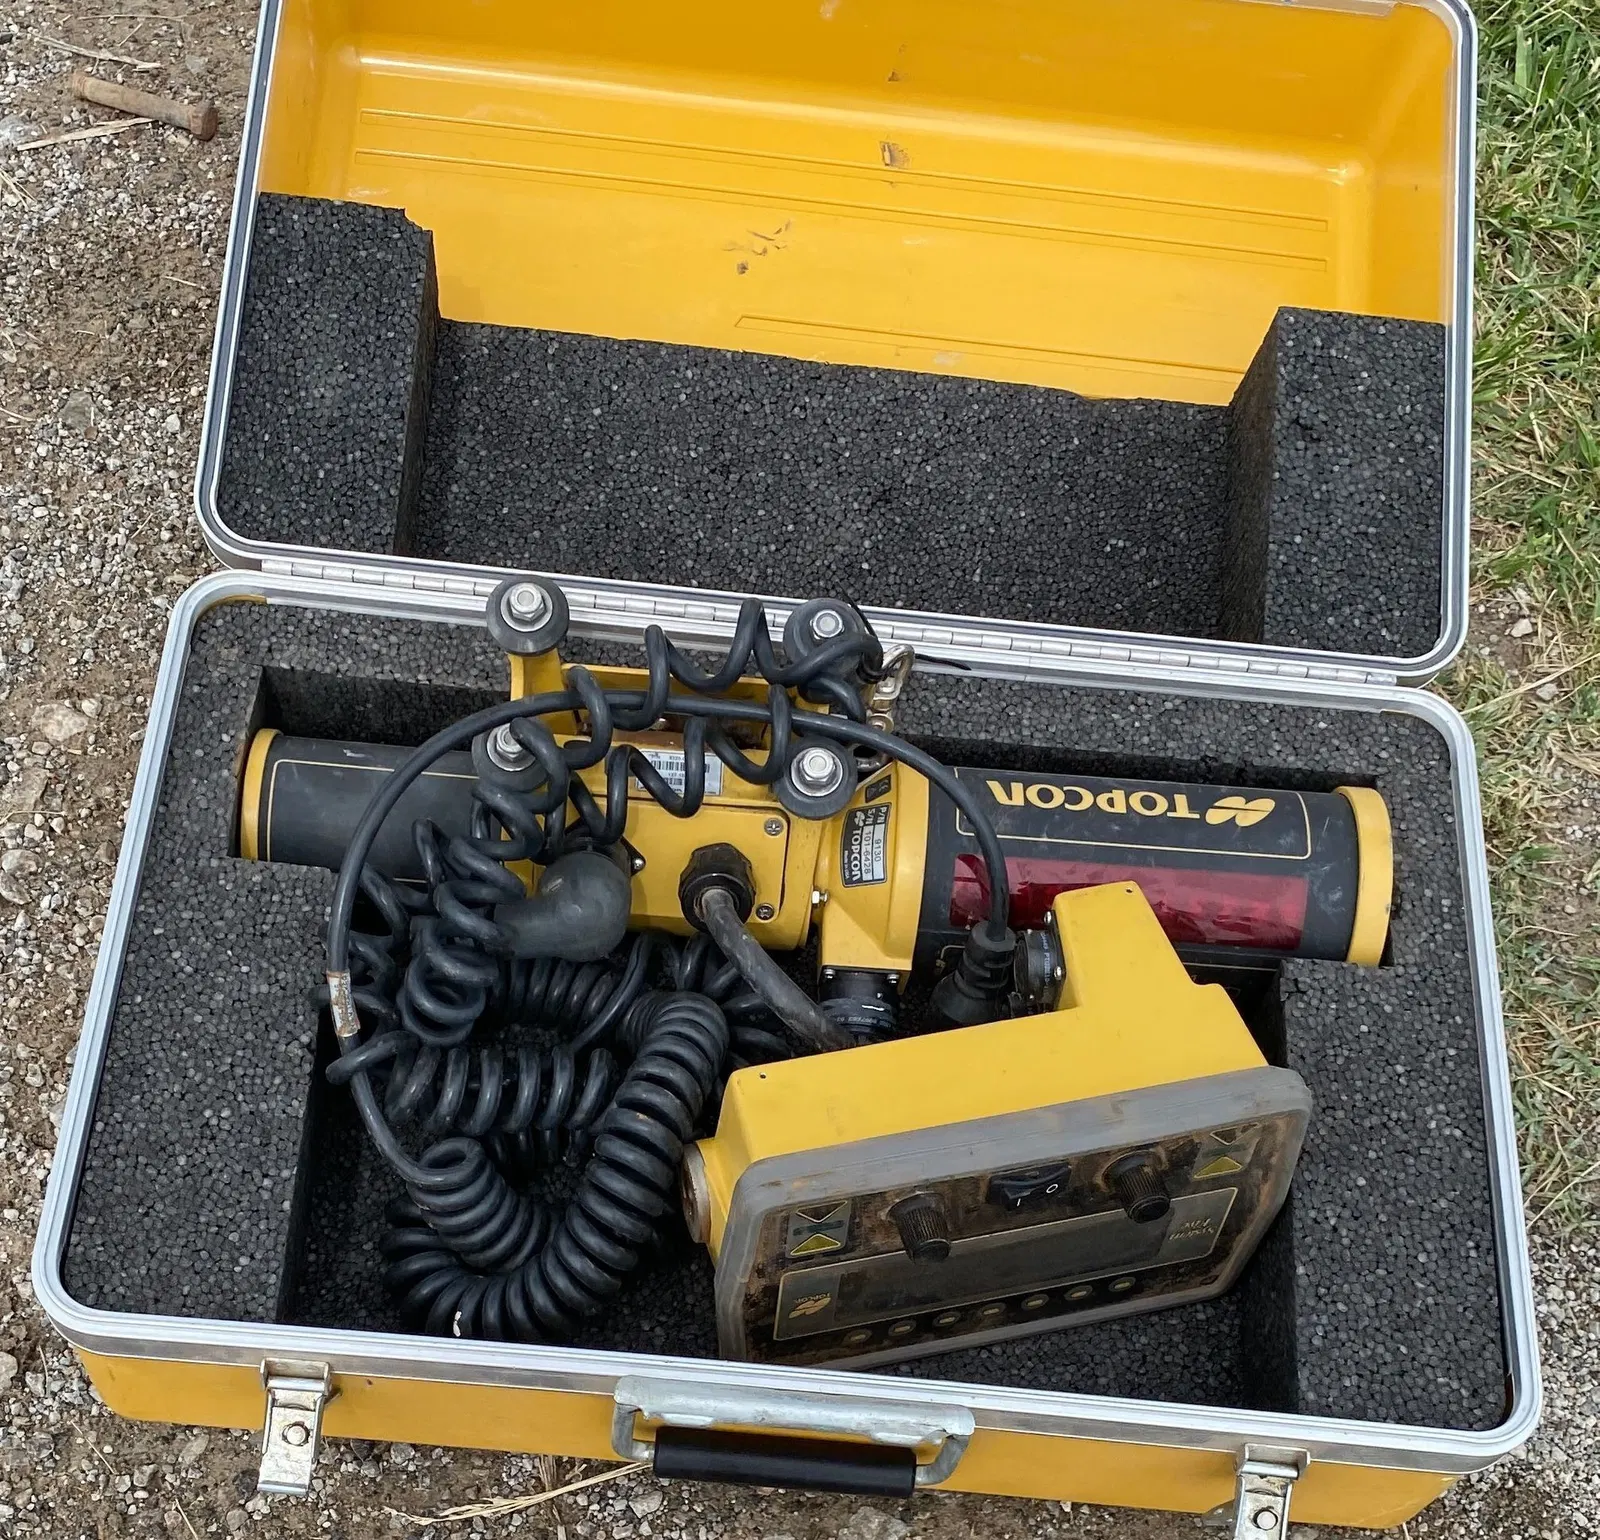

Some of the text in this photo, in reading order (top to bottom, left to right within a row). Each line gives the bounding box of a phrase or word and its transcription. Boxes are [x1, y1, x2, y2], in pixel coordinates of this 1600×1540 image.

[985, 780, 1201, 819] TOPCON
[851, 828, 862, 881] TOPCON
[863, 808, 875, 875] S/N 101-6428
[874, 806, 887, 863] P/N 9130
